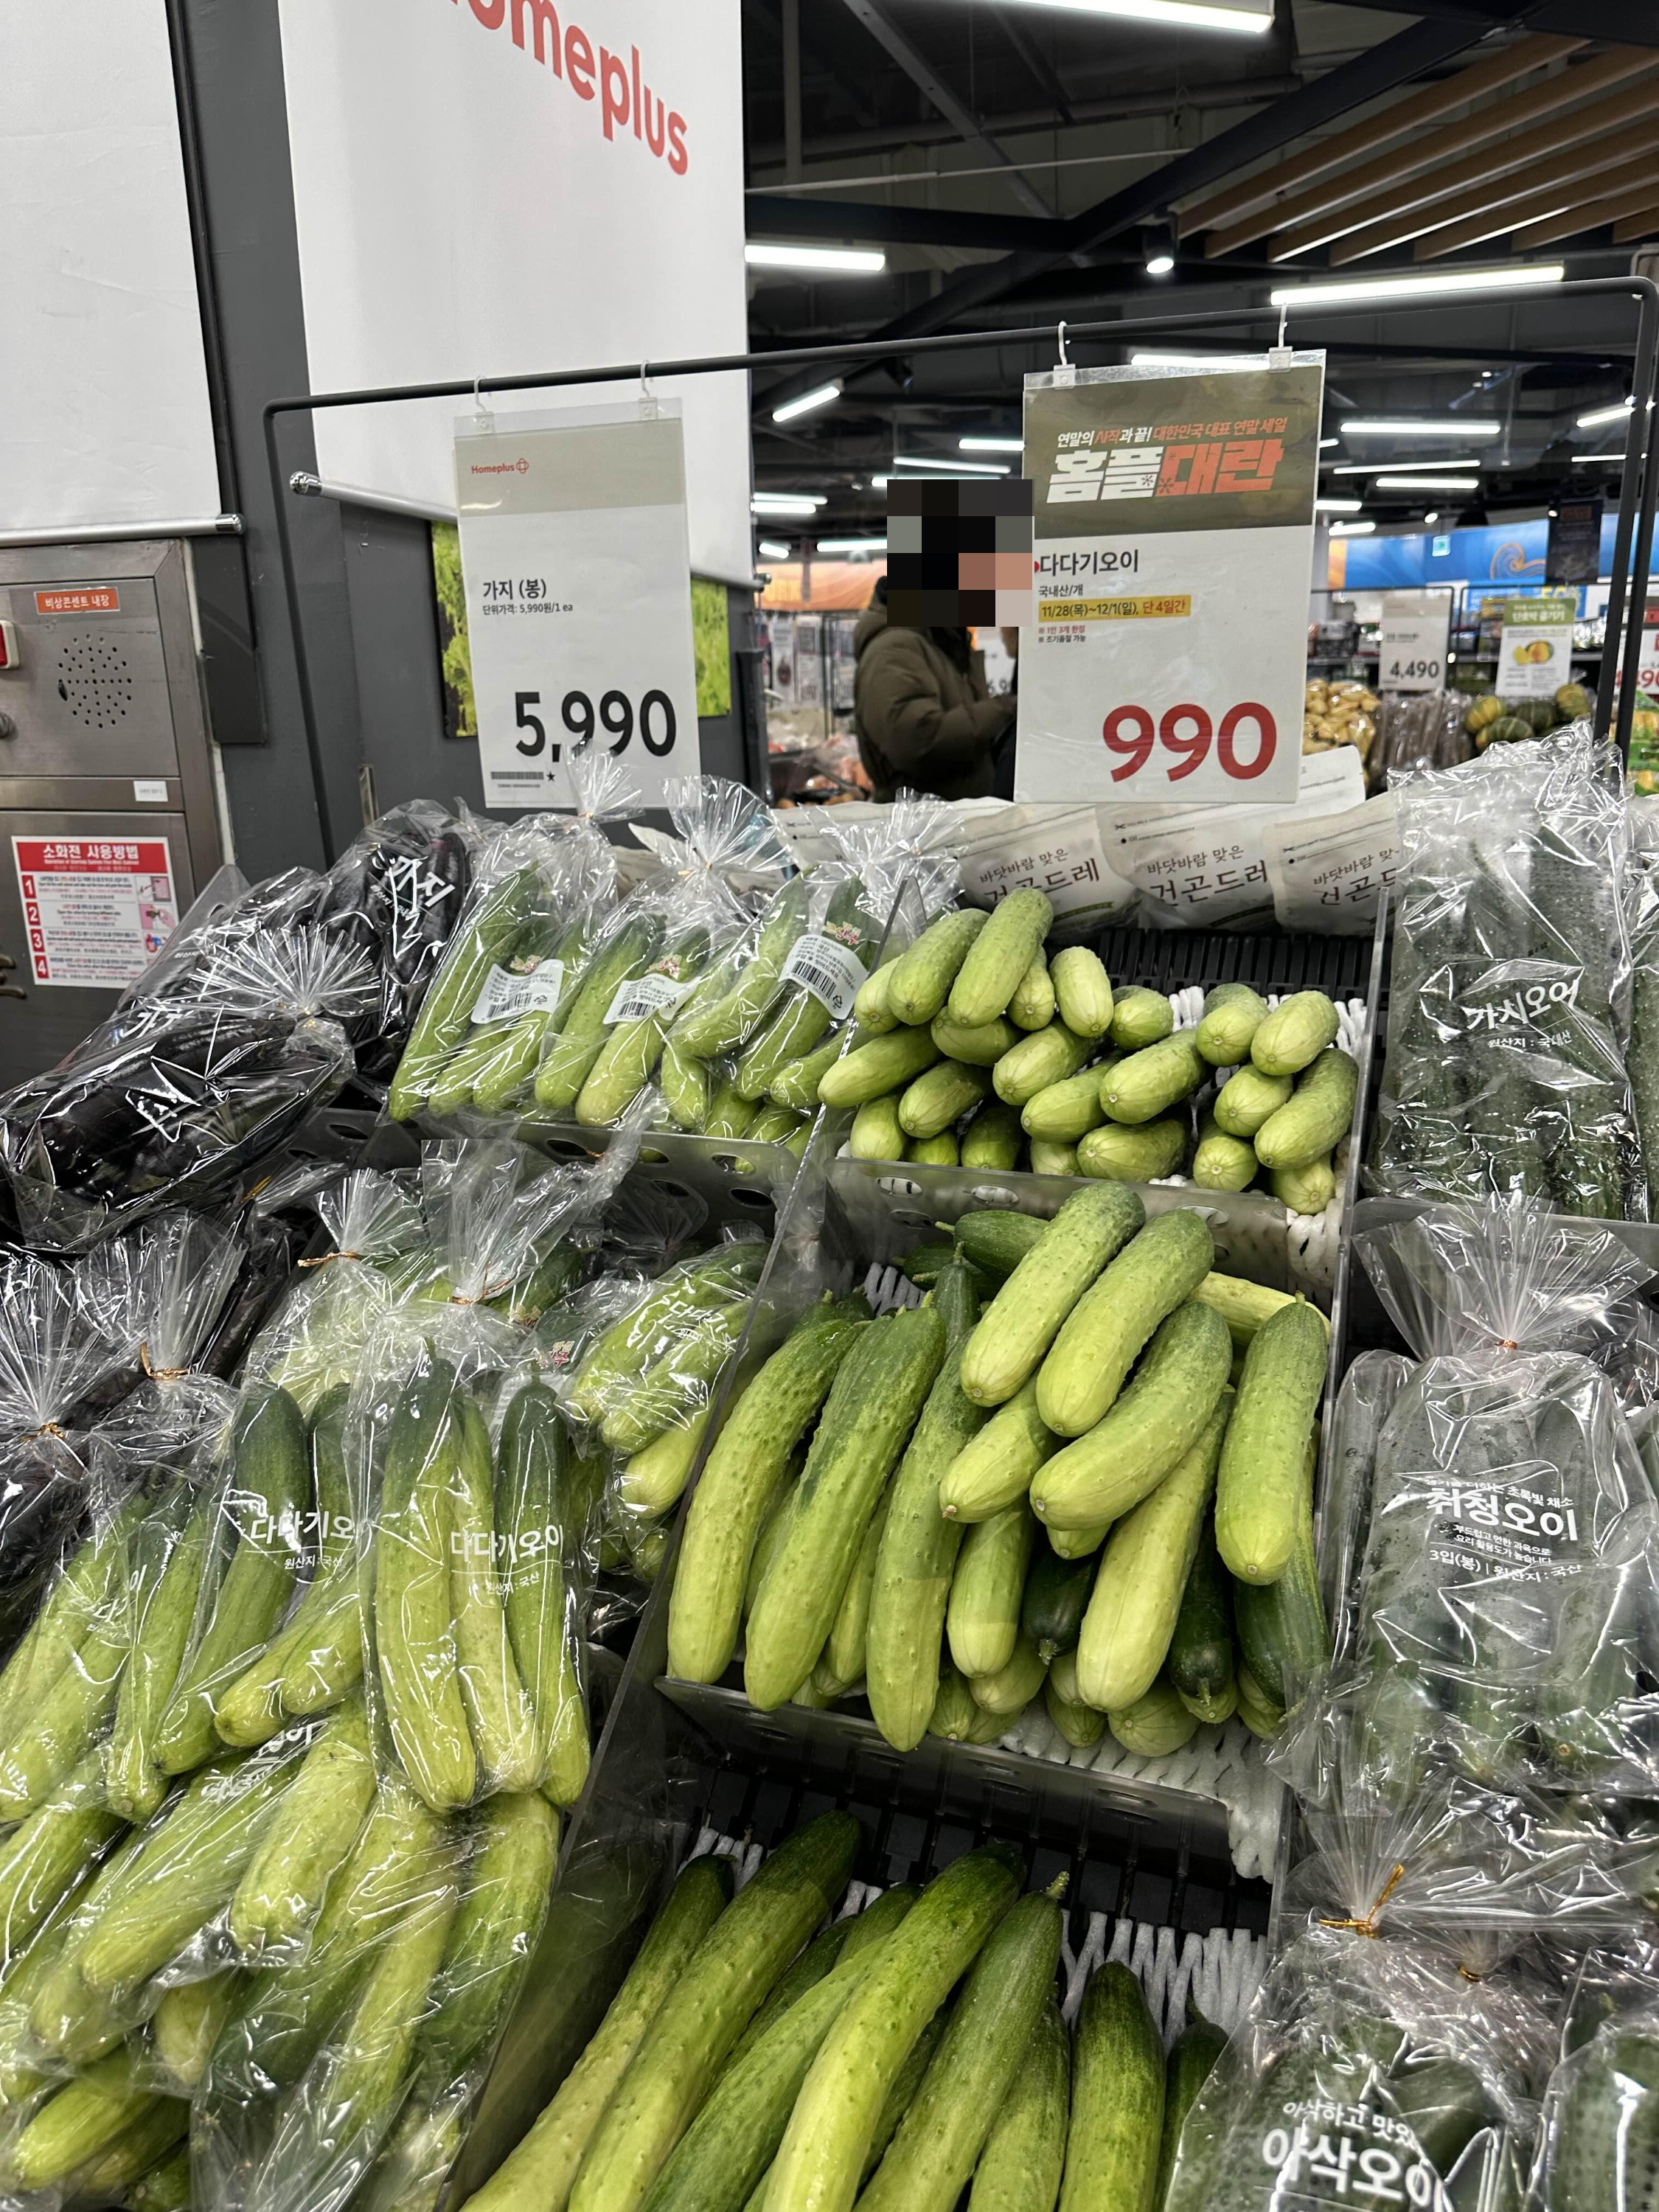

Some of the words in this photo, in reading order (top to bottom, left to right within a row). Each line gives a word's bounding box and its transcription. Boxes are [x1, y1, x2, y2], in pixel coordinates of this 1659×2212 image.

[451, 0, 687, 175] meplus
[1057, 431, 1095, 448] 연말의
[1093, 428, 1133, 445] 시작과
[1134, 427, 1152, 443] 끝!
[1152, 423, 1204, 441] 대한민국
[1205, 422, 1232, 437] 대표
[1234, 419, 1259, 436] 연말
[1260, 417, 1288, 434] 세일
[471, 463, 515, 474] Homeplus
[1046, 439, 1284, 504] 홈플대란
[1040, 549, 1138, 577] 다다기오이
[45, 596, 89, 609] 비상콘센트
[91, 594, 109, 607] 내장
[483, 580, 513, 601] 가지
[519, 579, 546, 599] (봉)
[1038, 584, 1084, 597] 국내산/개
[483, 604, 518, 616] 단위가격:
[520, 602, 560, 614] 5,990원/1
[563, 604, 574, 612] ea
[1143, 600, 1154, 614] 단
[1155, 599, 1186, 613] 4일간
[1389, 660, 1439, 679] 4,490
[515, 689, 676, 763] 5,990
[1103, 702, 1277, 782] 990
[43, 844, 82, 859] 소화전
[87, 844, 139, 860] 사용방법
[1147, 854, 1208, 875] 바닷바람
[1212, 845, 1244, 863] 맞은
[979, 857, 1035, 883] 바닷바람
[1039, 848, 1068, 866] 맞은
[1313, 855, 1374, 886] 바닷바람
[1379, 848, 1399, 863] 맞
[25, 879, 34, 895] 1
[28, 907, 38, 922] 2
[32, 933, 43, 948] 3
[38, 960, 47, 975] 4
[1466, 979, 1580, 1030] 가시오이
[1488, 1037, 1526, 1048] 원산지
[1507, 1485, 1545, 1506] 초록빛
[1546, 1497, 1574, 1509] 채소
[1426, 1487, 1578, 1541] 취청오이
[251, 1511, 355, 1545] 다다기오
[1453, 1534, 1474, 1546] 요리
[451, 1525, 563, 1563] 다다기오이
[284, 1554, 316, 1570] 원산지
[1429, 1549, 1481, 1573] 3입(봉)
[1551, 1565, 1585, 1577] 국산
[519, 1571, 540, 1587] 국산
[1282, 2098, 1366, 2130] 아삭하고
[1262, 2126, 1444, 2212] 아삭오이
